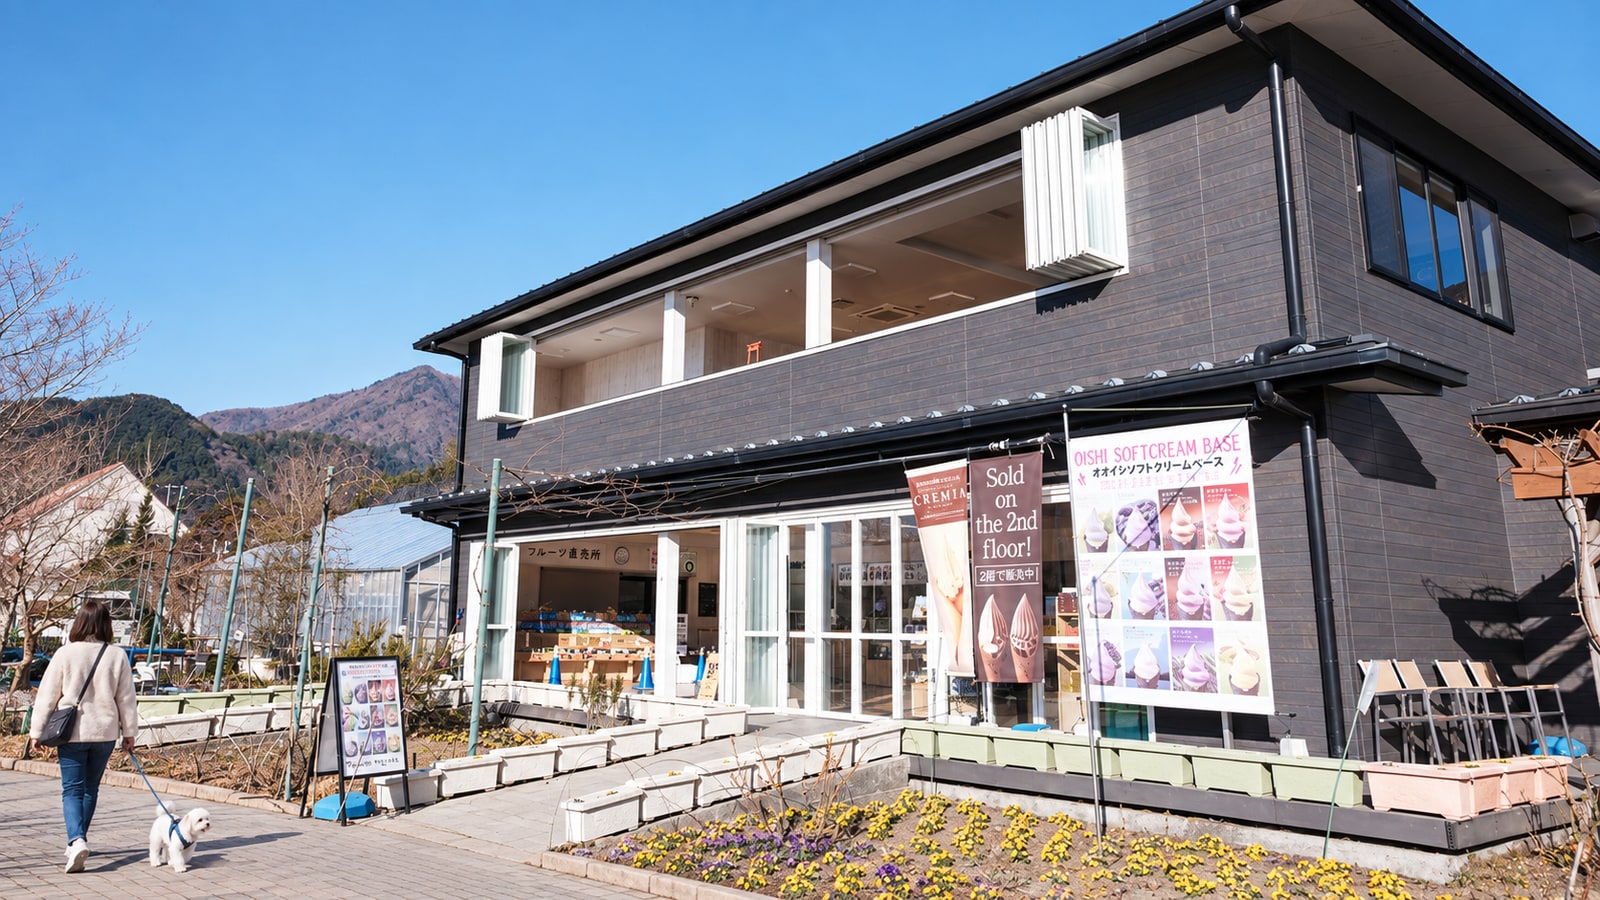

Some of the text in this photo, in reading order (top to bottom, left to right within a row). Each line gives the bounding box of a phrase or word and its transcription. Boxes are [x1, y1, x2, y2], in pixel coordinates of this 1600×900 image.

[1074, 434, 1241, 467] OISHI SOFTCREAM BASE
[986, 463, 1025, 488] Sold
[1092, 456, 1224, 478] オオイシソフトクリームベース
[914, 487, 967, 506] CREMIA
[995, 493, 1018, 509] on
[976, 513, 1003, 534] the
[1006, 510, 1038, 532] 2nd
[527, 546, 601, 561] フルーツ直売所
[982, 536, 1031, 559] floor!
